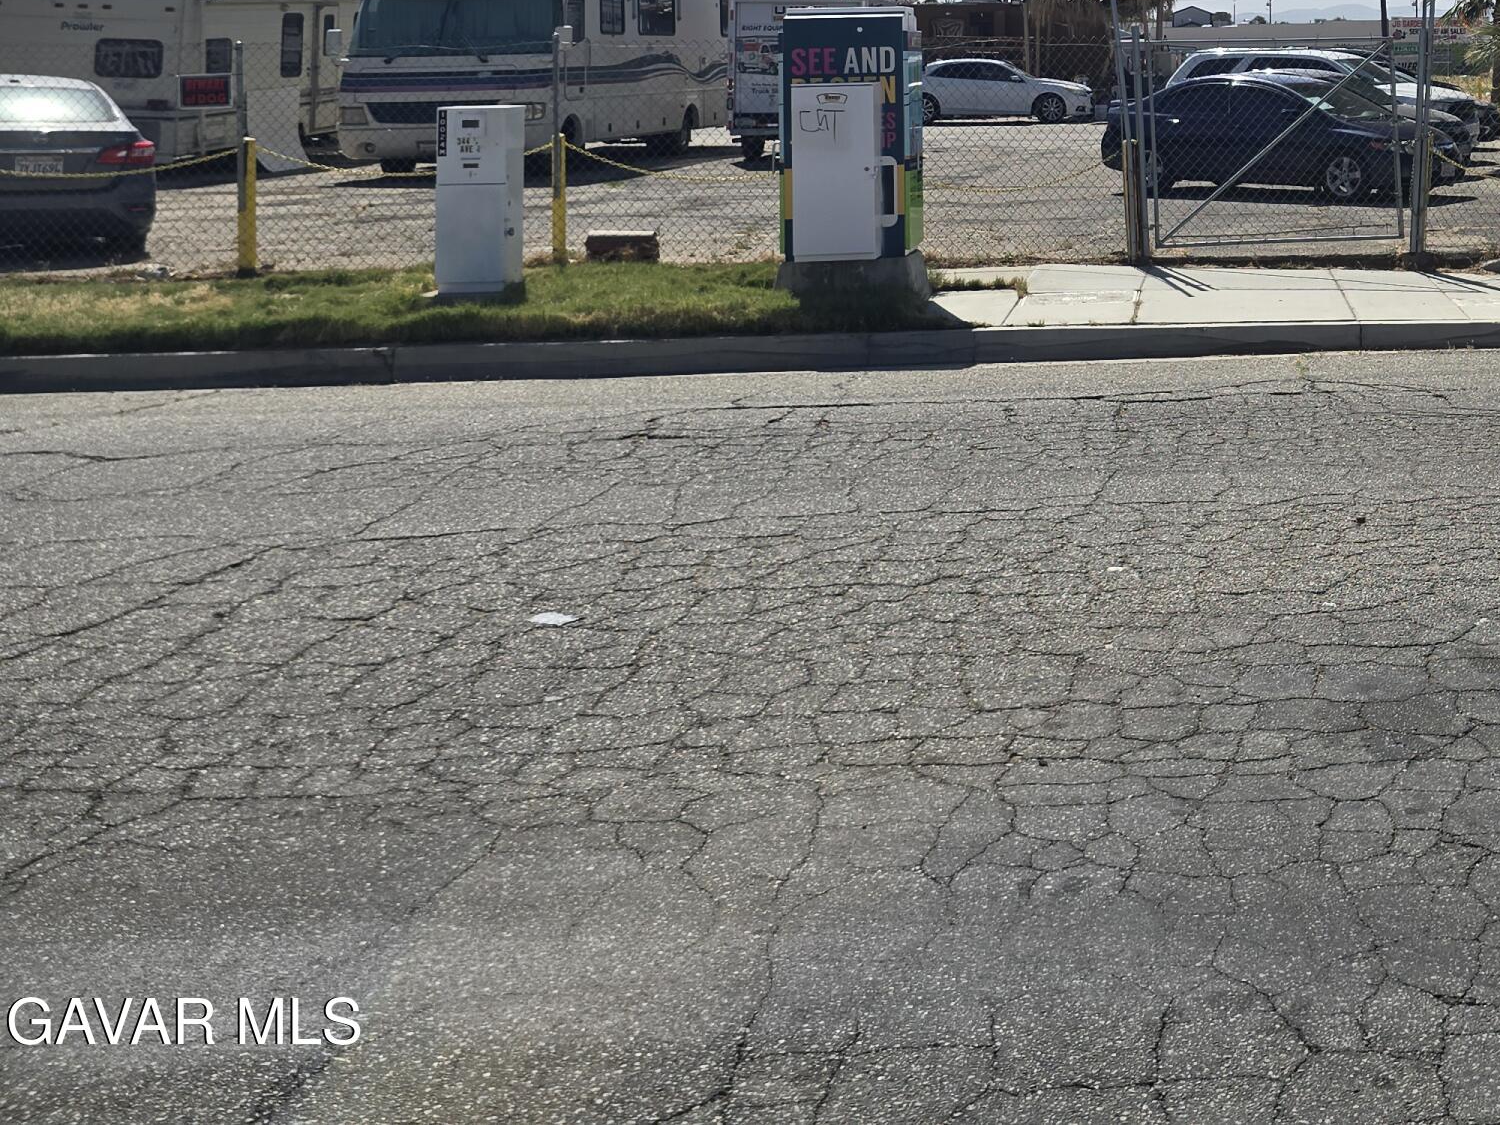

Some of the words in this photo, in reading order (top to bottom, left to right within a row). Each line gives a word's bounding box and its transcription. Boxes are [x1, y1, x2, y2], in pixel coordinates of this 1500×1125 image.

[60, 22, 104, 32] Prowler
[791, 48, 837, 75] SEE
[844, 46, 895, 74] AND
[197, 93, 226, 104] DOG
